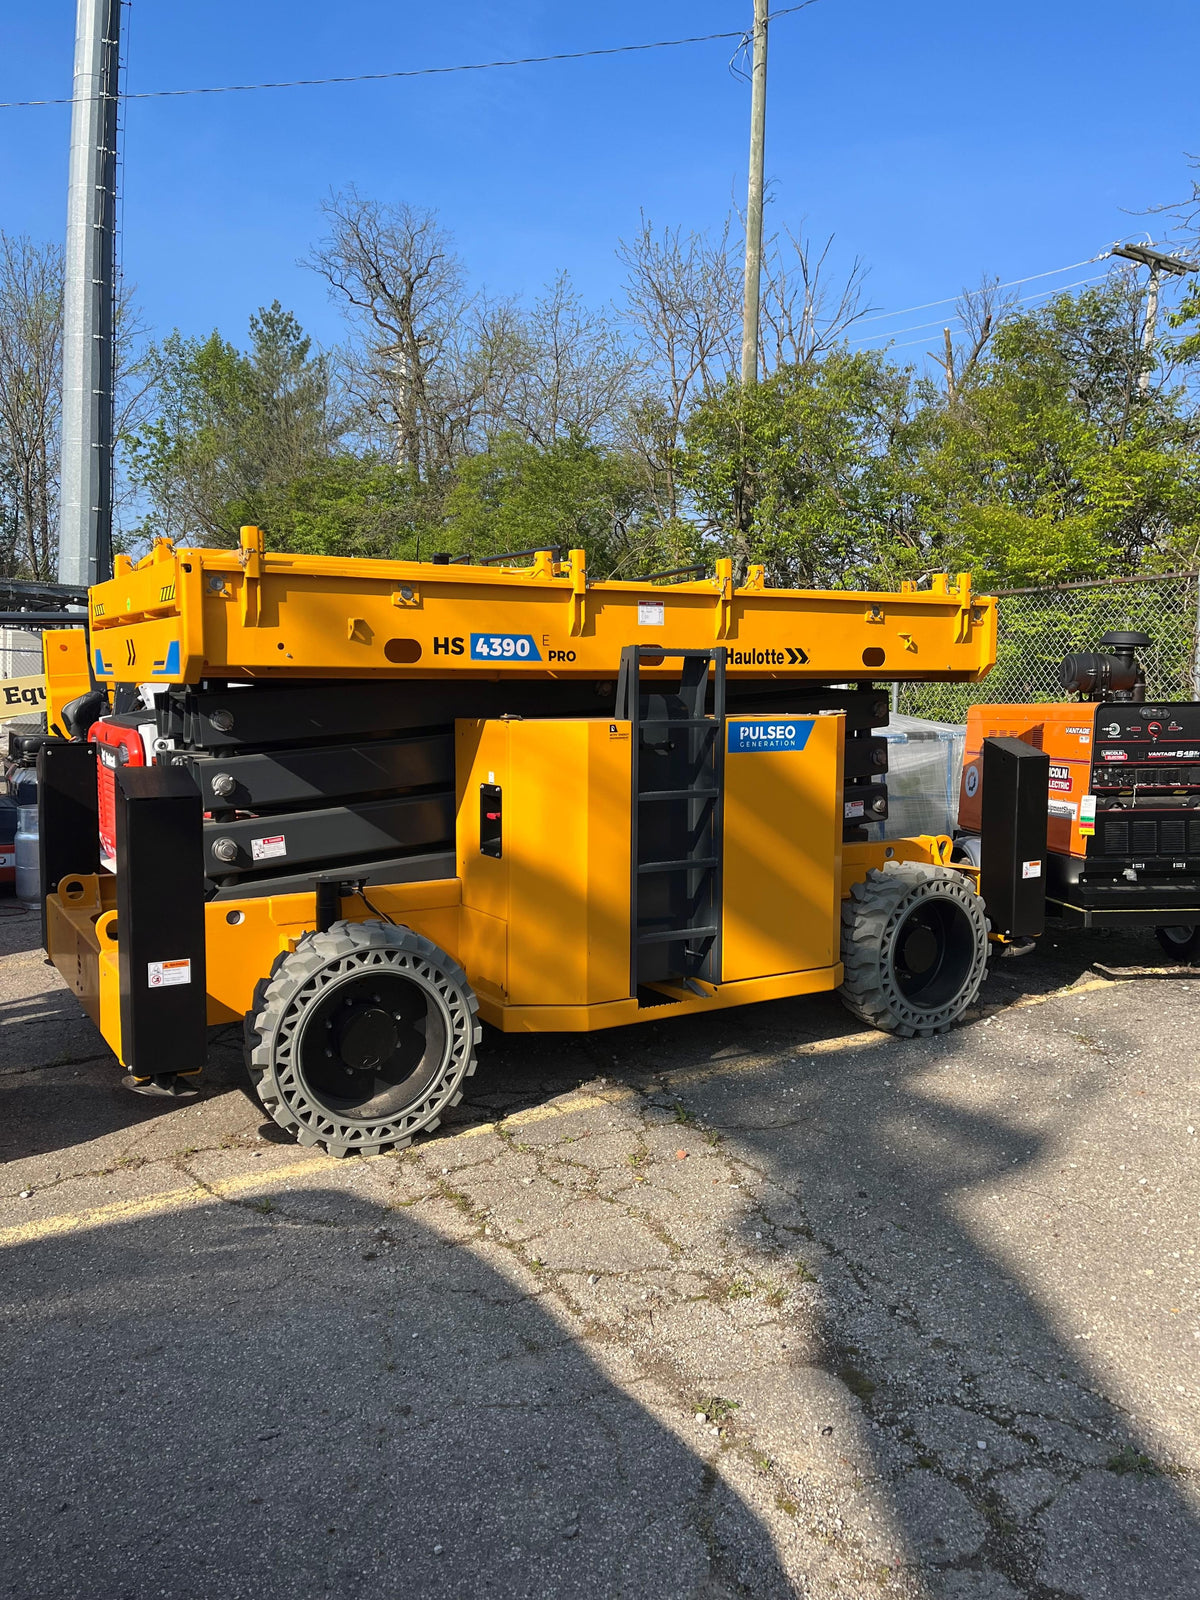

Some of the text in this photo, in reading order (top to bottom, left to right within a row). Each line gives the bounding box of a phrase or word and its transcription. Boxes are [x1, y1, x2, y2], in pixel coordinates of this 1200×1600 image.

[433, 634, 576, 662] HS 4390 E PRO
[725, 647, 785, 665] Haulotte
[740, 725, 796, 740] PULSEO
[1065, 727, 1091, 735] VANTAGE
[739, 740, 796, 748] GENERATION
